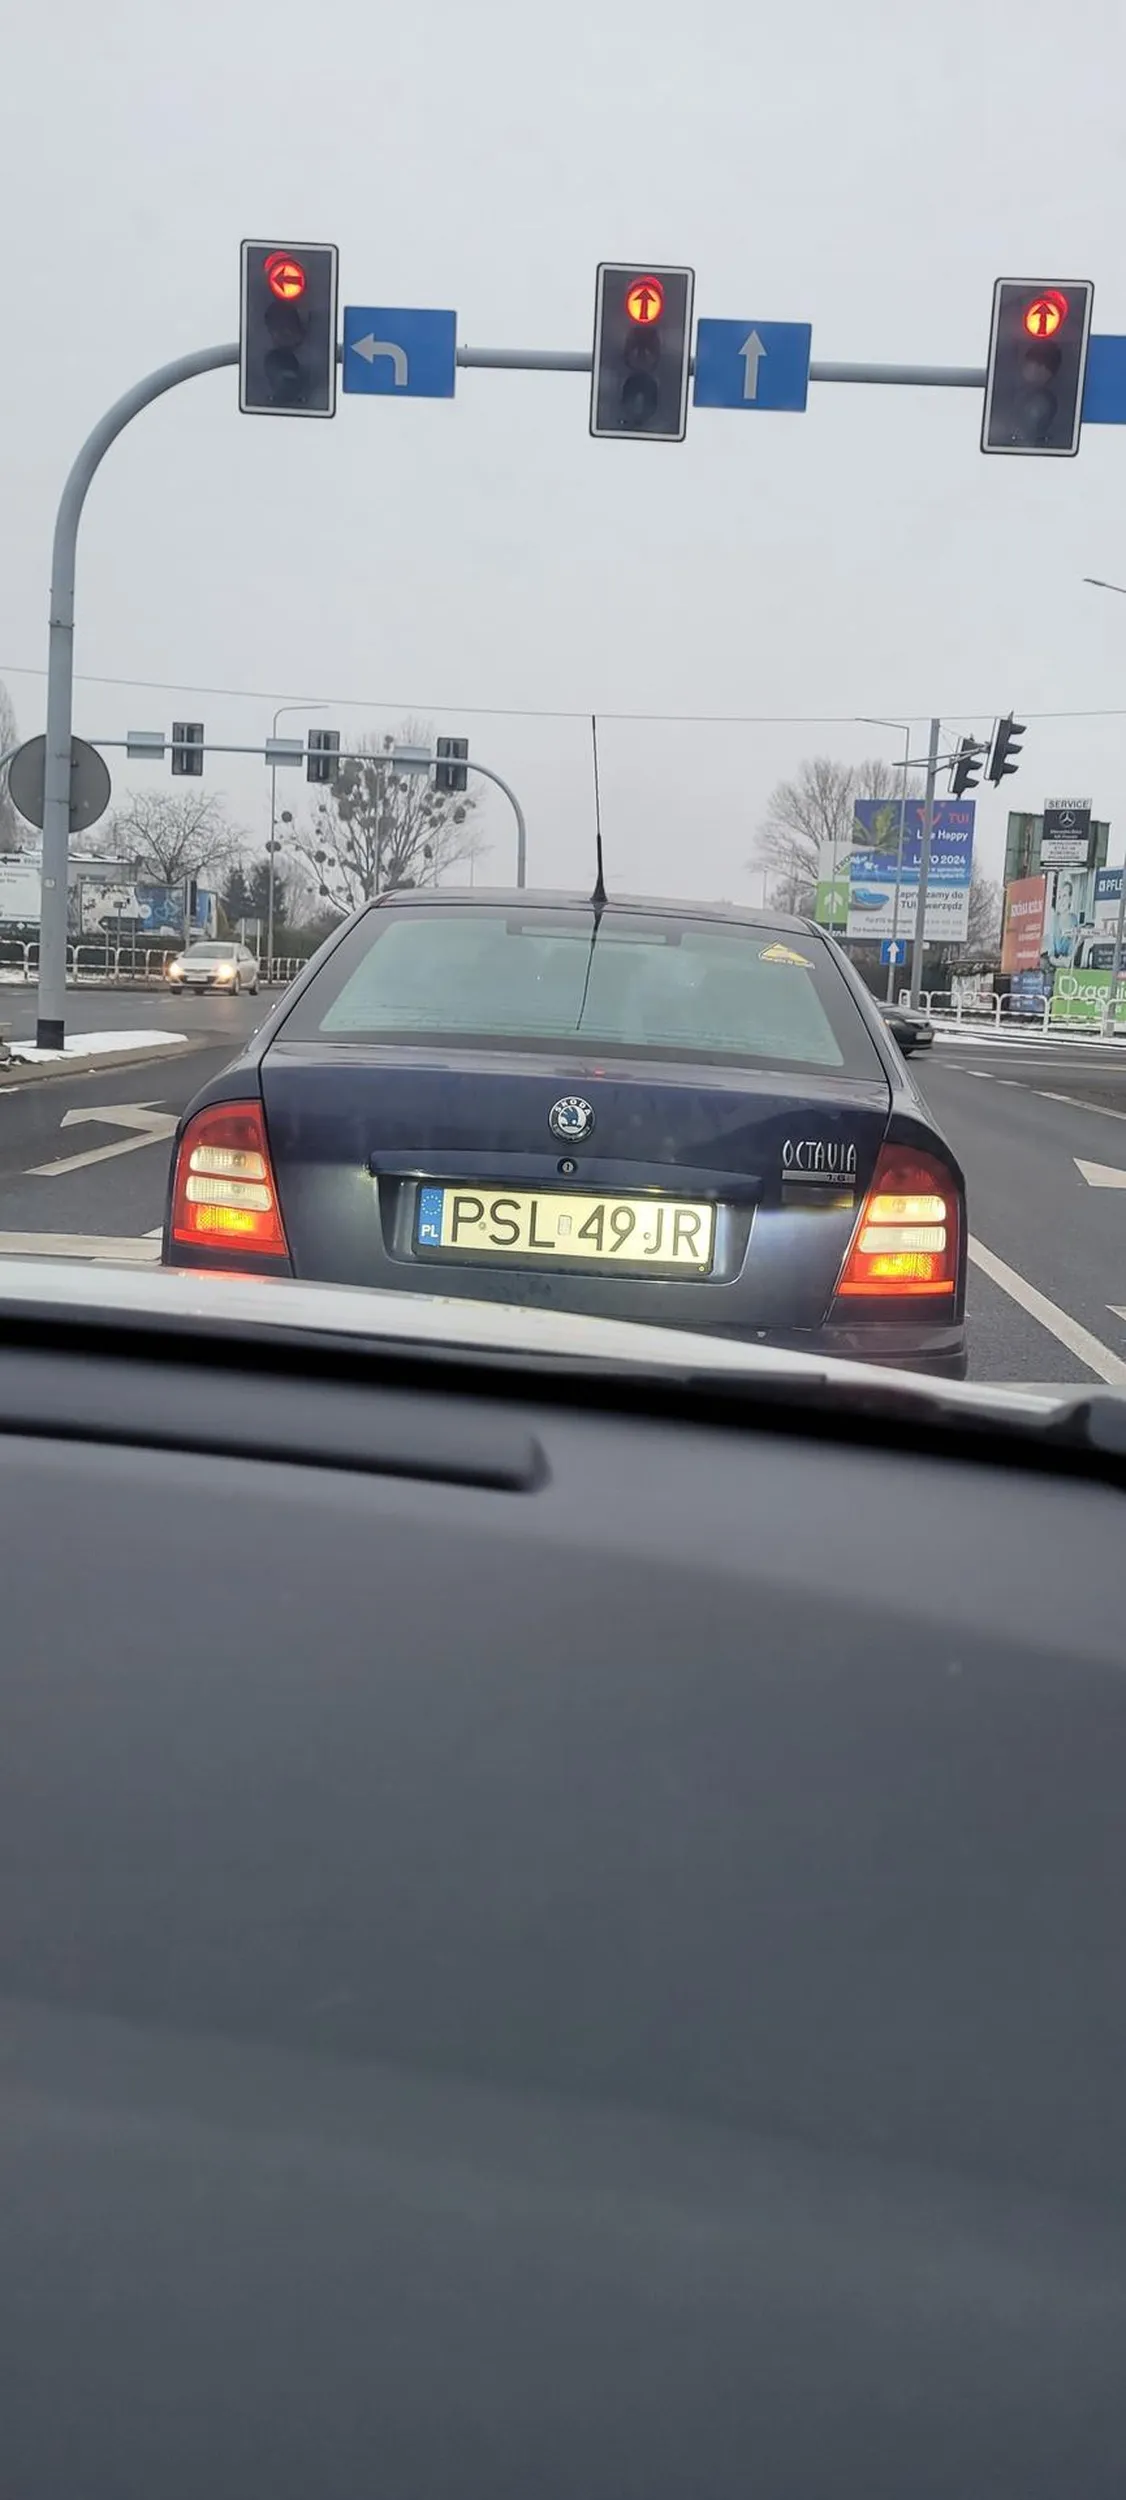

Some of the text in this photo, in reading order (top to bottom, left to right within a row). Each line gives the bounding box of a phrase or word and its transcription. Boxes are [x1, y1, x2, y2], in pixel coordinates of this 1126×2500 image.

[1048, 800, 1088, 808] SERVICE
[949, 812, 969, 824] TUI
[917, 829, 968, 842] Le Happy
[940, 855, 966, 864] 2024
[951, 891, 963, 899] do
[782, 1140, 857, 1171] OCTAVIA
[451, 1196, 555, 1249] PSL
[421, 1223, 438, 1238] PL
